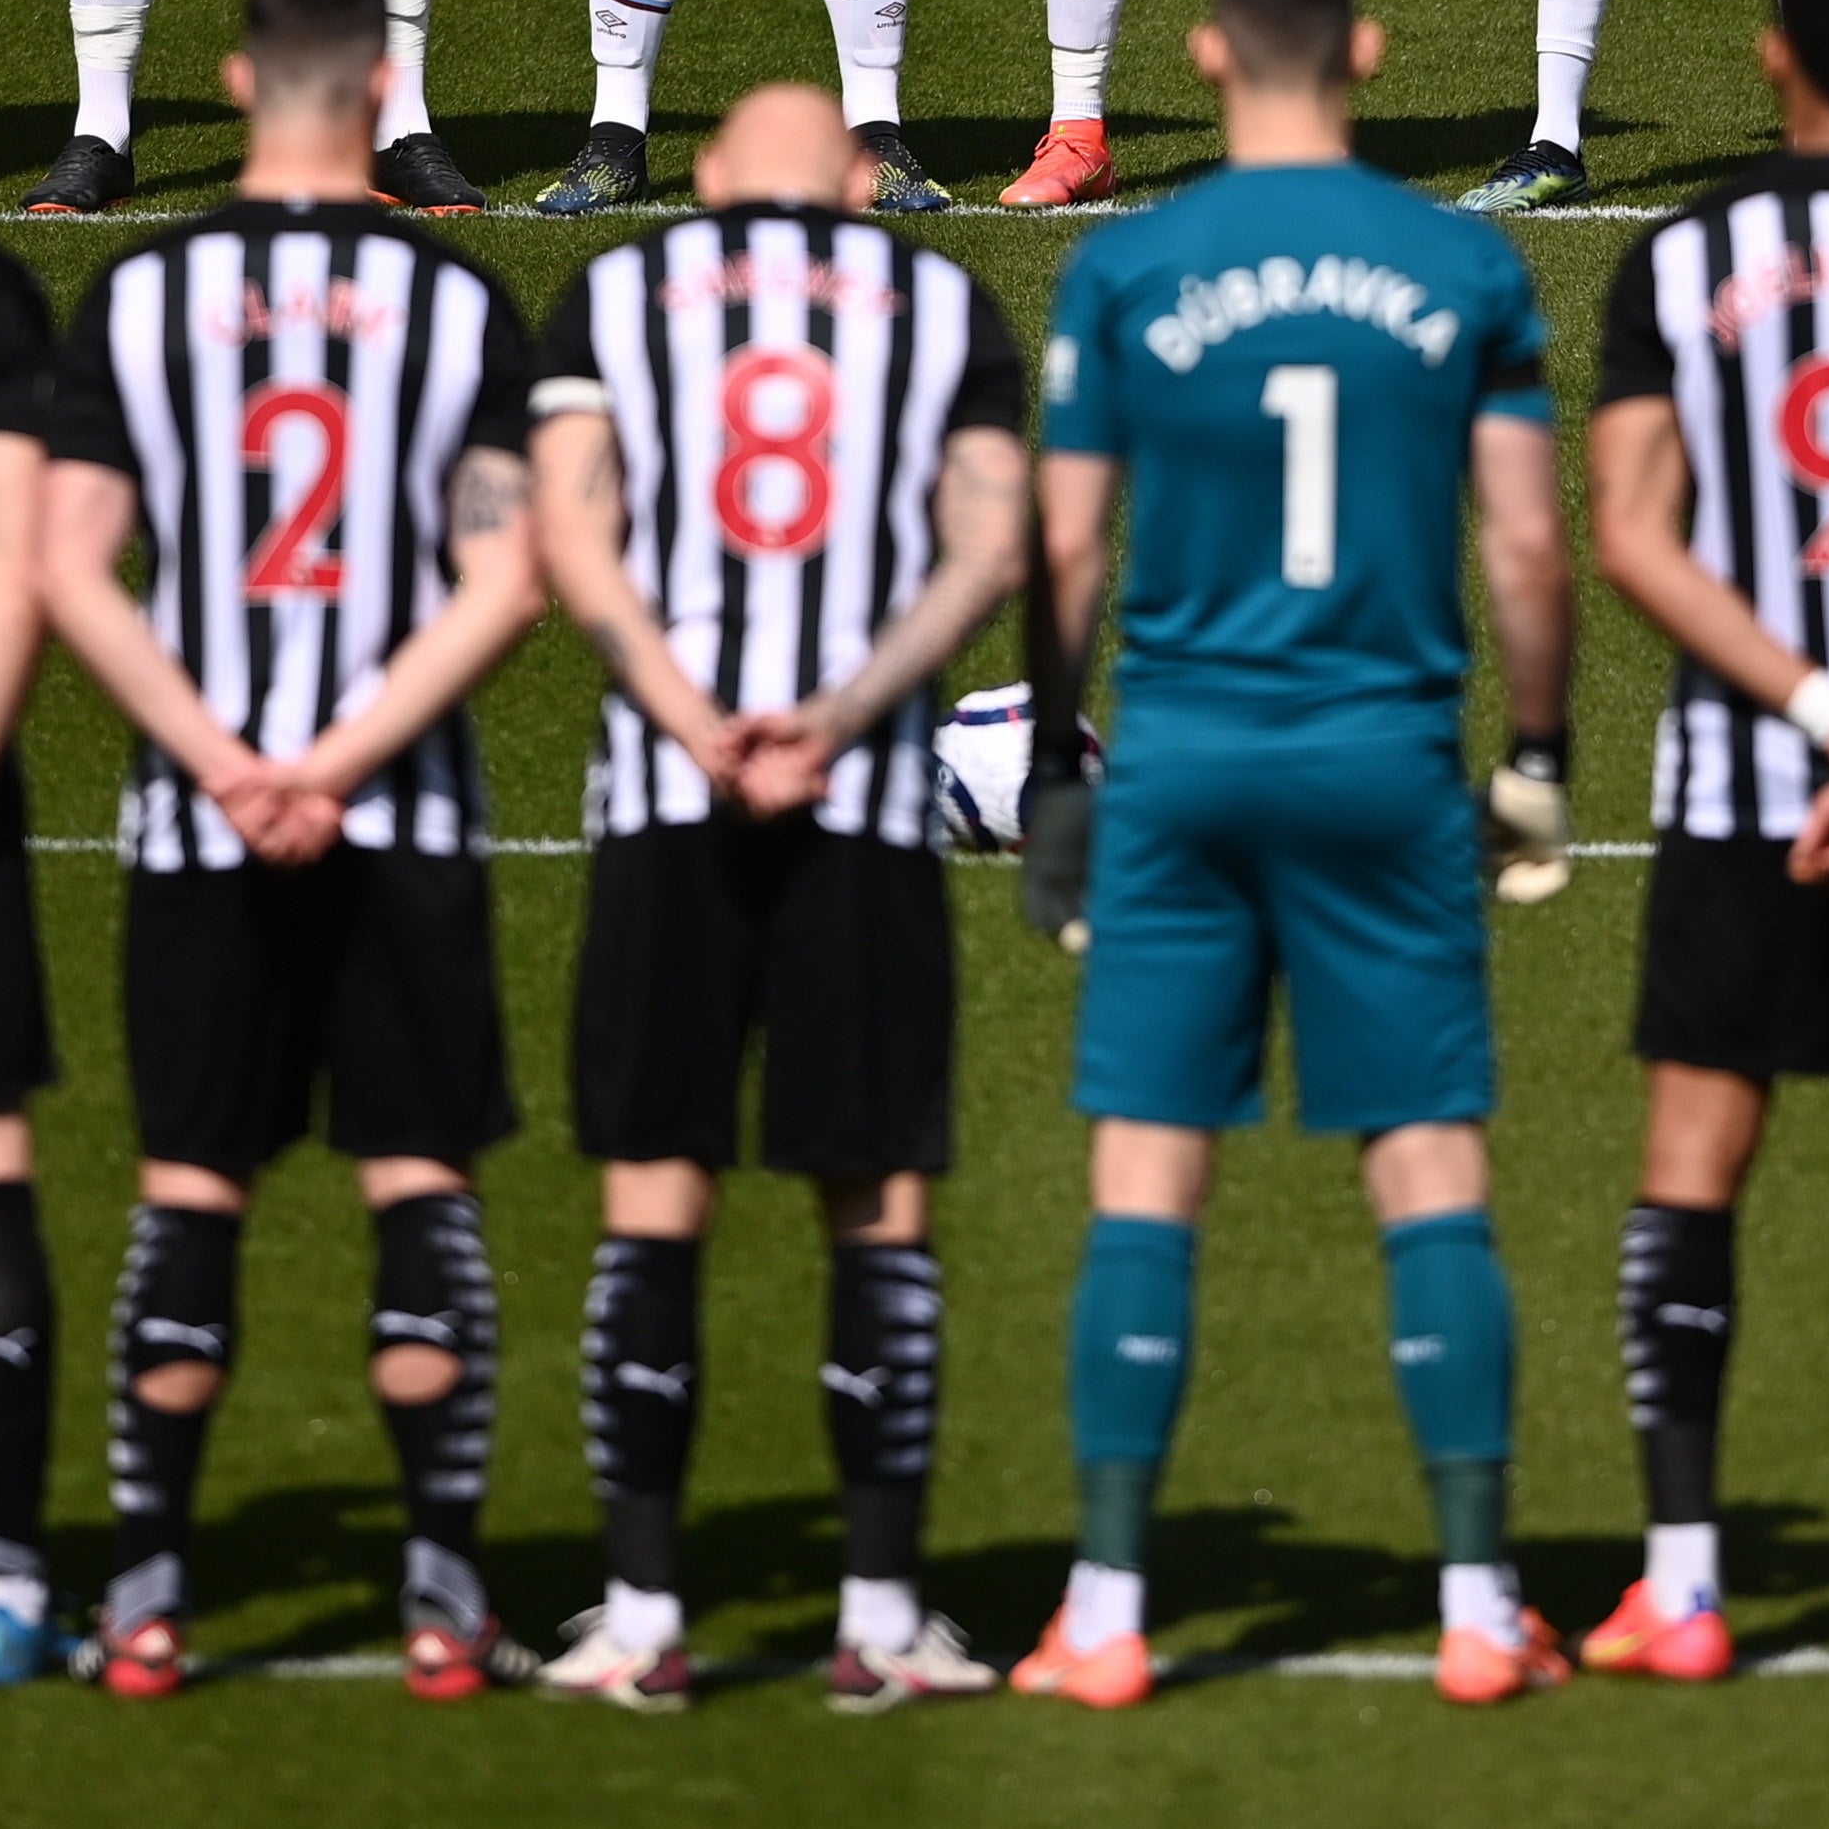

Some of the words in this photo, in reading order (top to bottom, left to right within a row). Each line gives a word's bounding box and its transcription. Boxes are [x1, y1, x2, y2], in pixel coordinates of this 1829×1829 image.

[239, 379, 352, 604] 2
[711, 342, 835, 559] 8
[1260, 365, 1339, 589] 1
